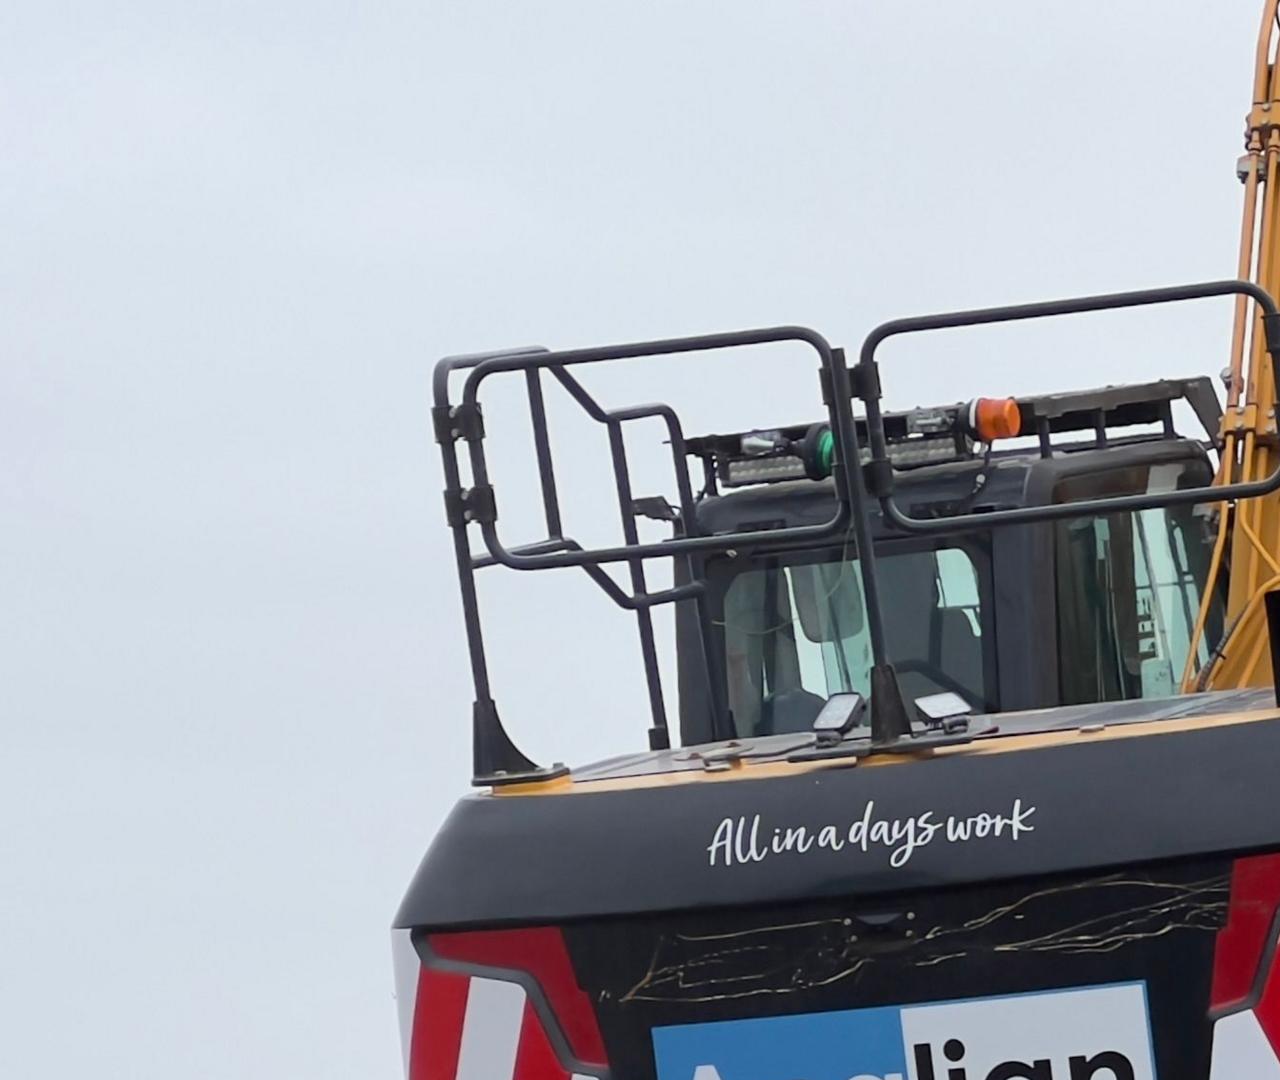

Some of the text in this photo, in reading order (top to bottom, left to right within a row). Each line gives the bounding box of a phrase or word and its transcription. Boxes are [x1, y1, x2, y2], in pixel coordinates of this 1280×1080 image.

[706, 798, 1036, 868] All in a days work
